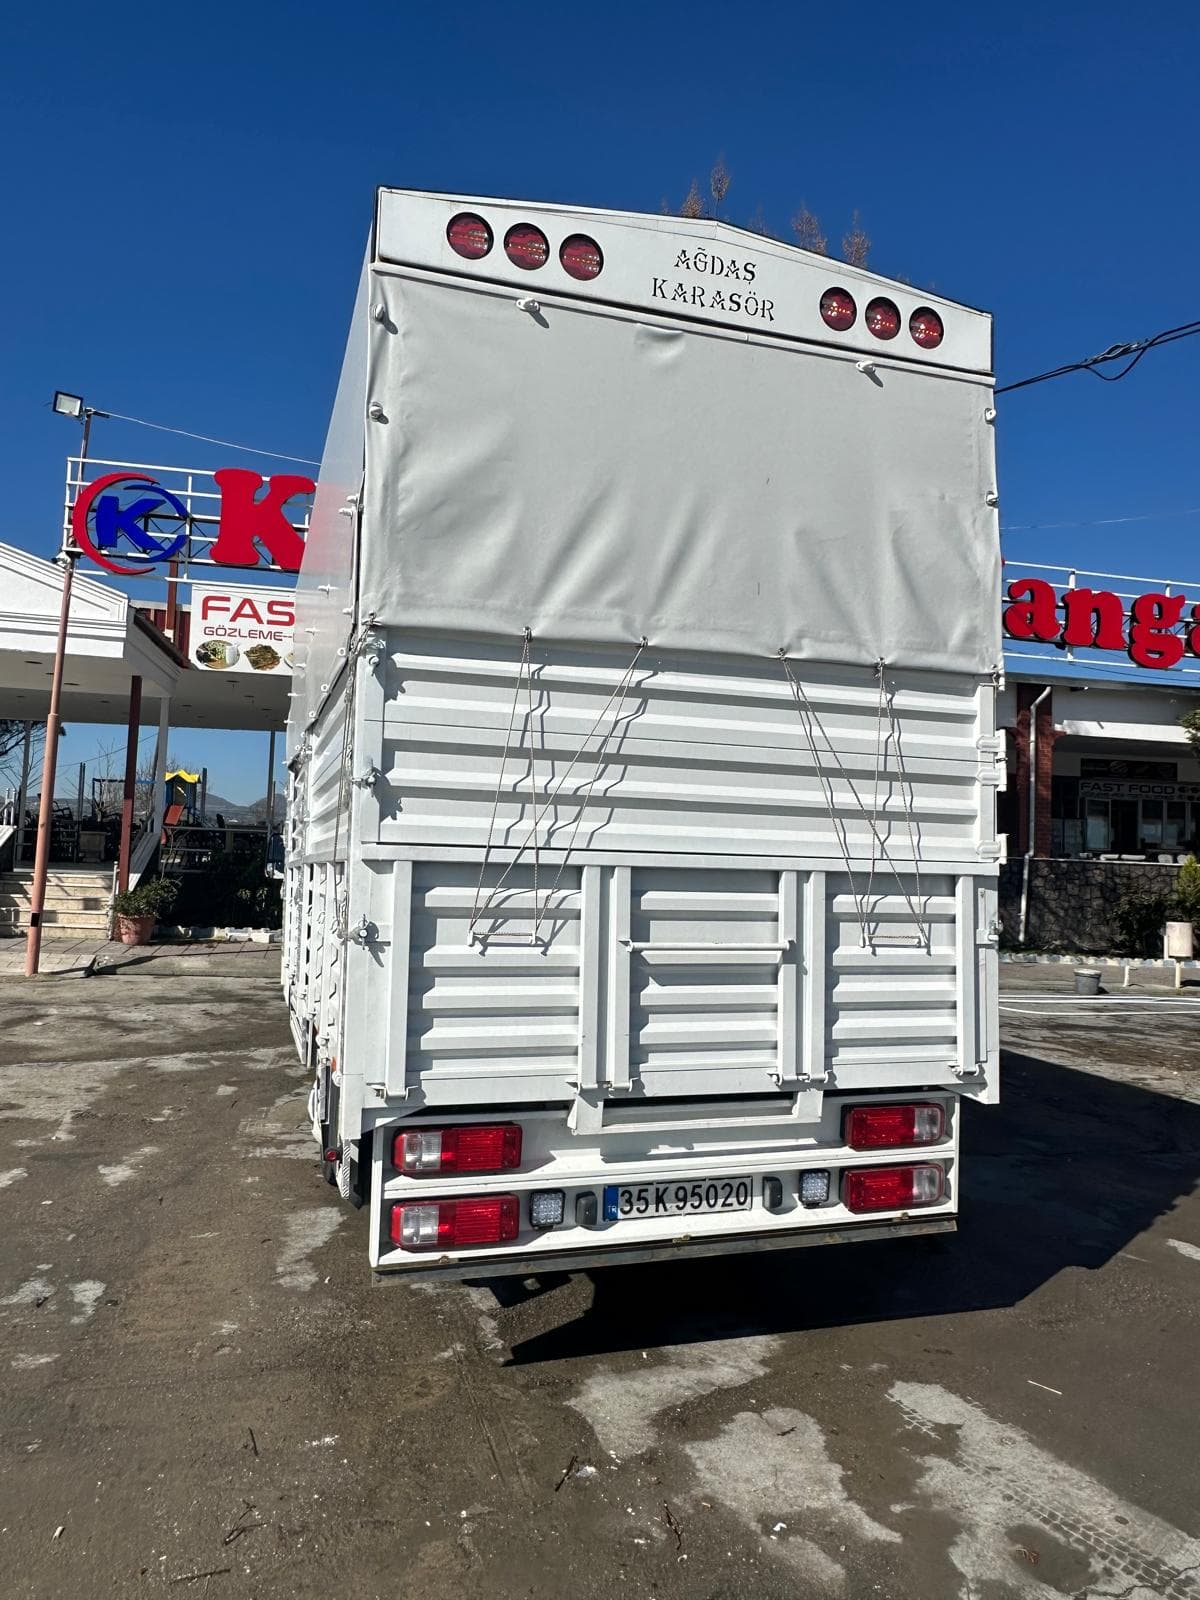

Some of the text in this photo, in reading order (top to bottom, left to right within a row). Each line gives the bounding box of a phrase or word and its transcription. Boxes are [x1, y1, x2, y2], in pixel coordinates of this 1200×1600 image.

[674, 247, 756, 285] AĞDAŞ
[652, 277, 775, 321] KARASÖR
[209, 468, 316, 570] K
[202, 595, 296, 627] FAS
[1003, 578, 1200, 669] ang
[1080, 782, 1175, 795] FAST FOOD
